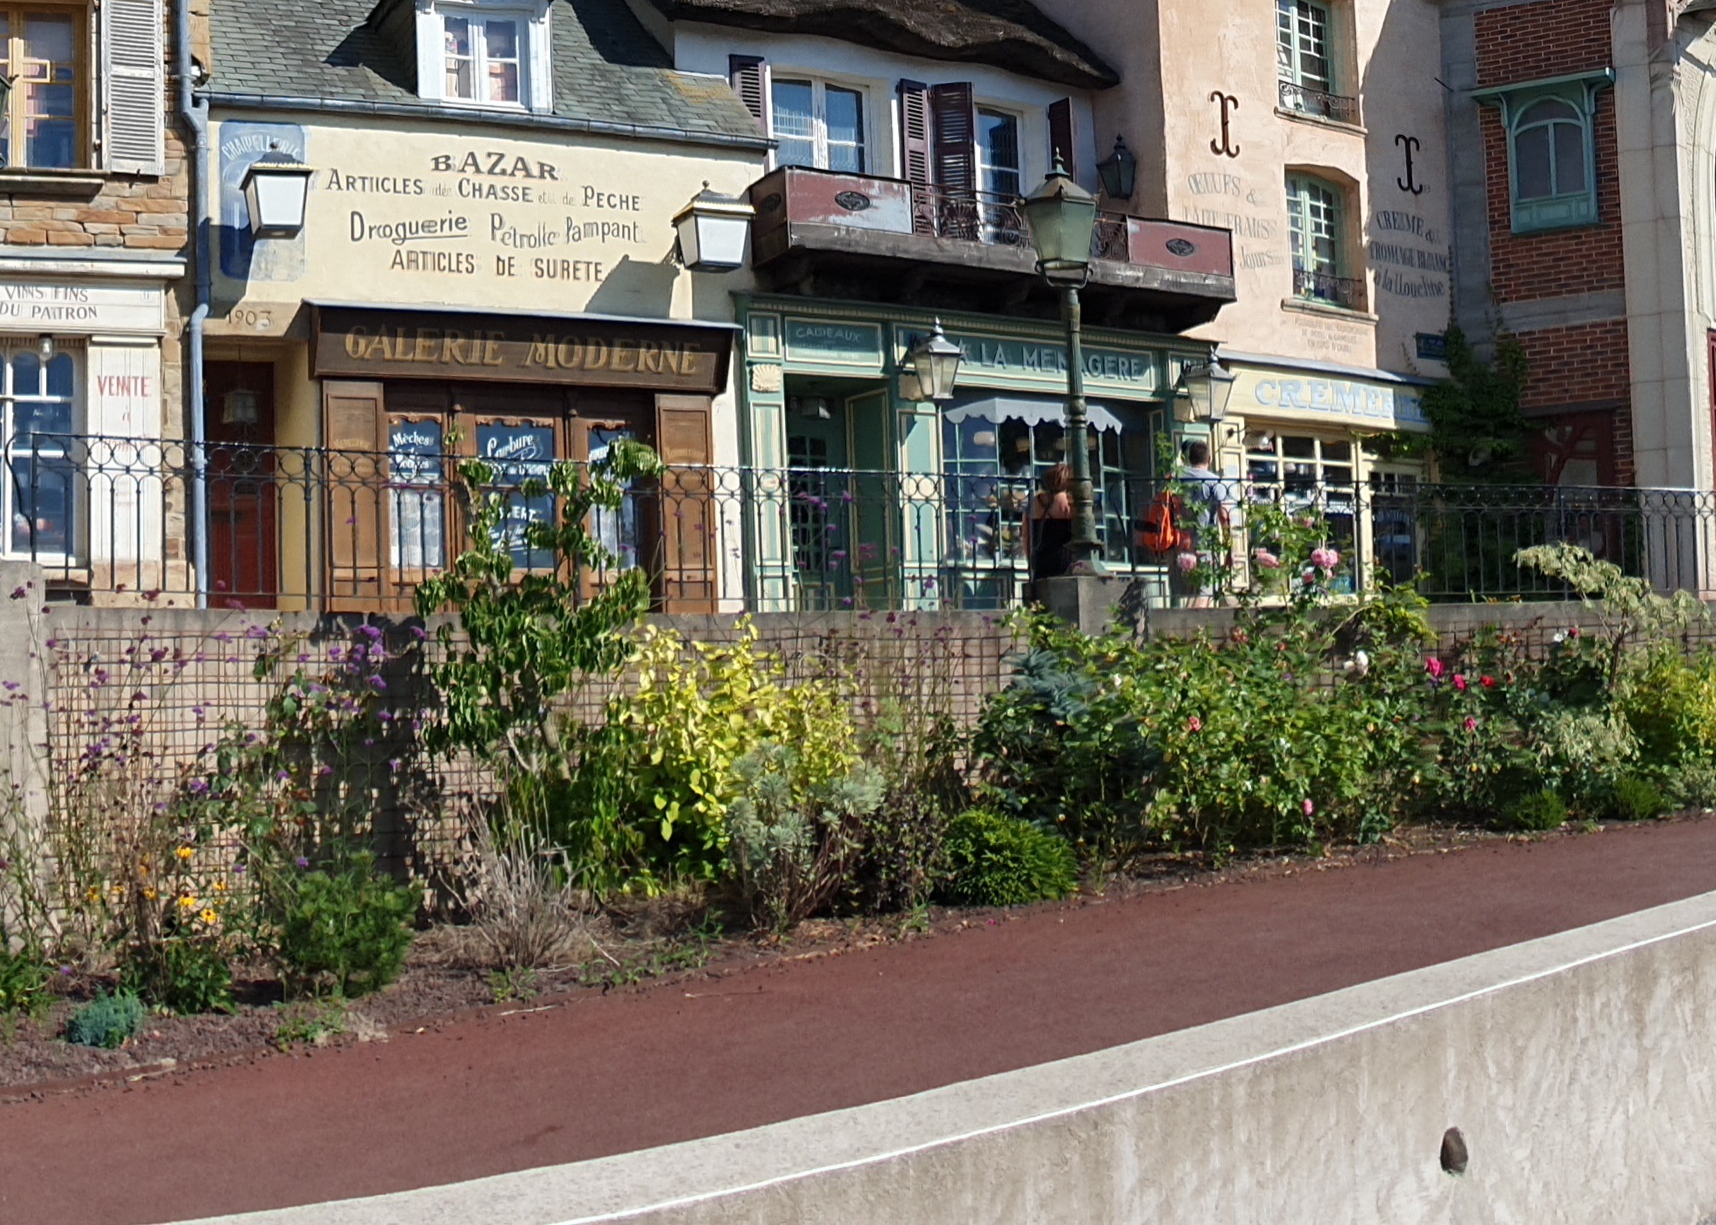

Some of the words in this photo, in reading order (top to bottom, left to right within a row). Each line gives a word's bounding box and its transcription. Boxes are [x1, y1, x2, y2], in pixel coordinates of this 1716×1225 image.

[431, 151, 559, 181] BAZAR
[458, 177, 533, 203] CHASSE
[562, 192, 574, 207] de
[583, 185, 641, 212] PECHE
[350, 210, 469, 245] Droguerie
[391, 249, 475, 275] ARTICLES
[496, 255, 516, 277] DE
[534, 257, 604, 282] SURETE
[344, 325, 506, 366] GALERIE
[525, 332, 702, 375] MODERNE
[980, 343, 1007, 370] LA
[1021, 346, 1144, 383] MENGERE
[97, 375, 152, 398] VENTE
